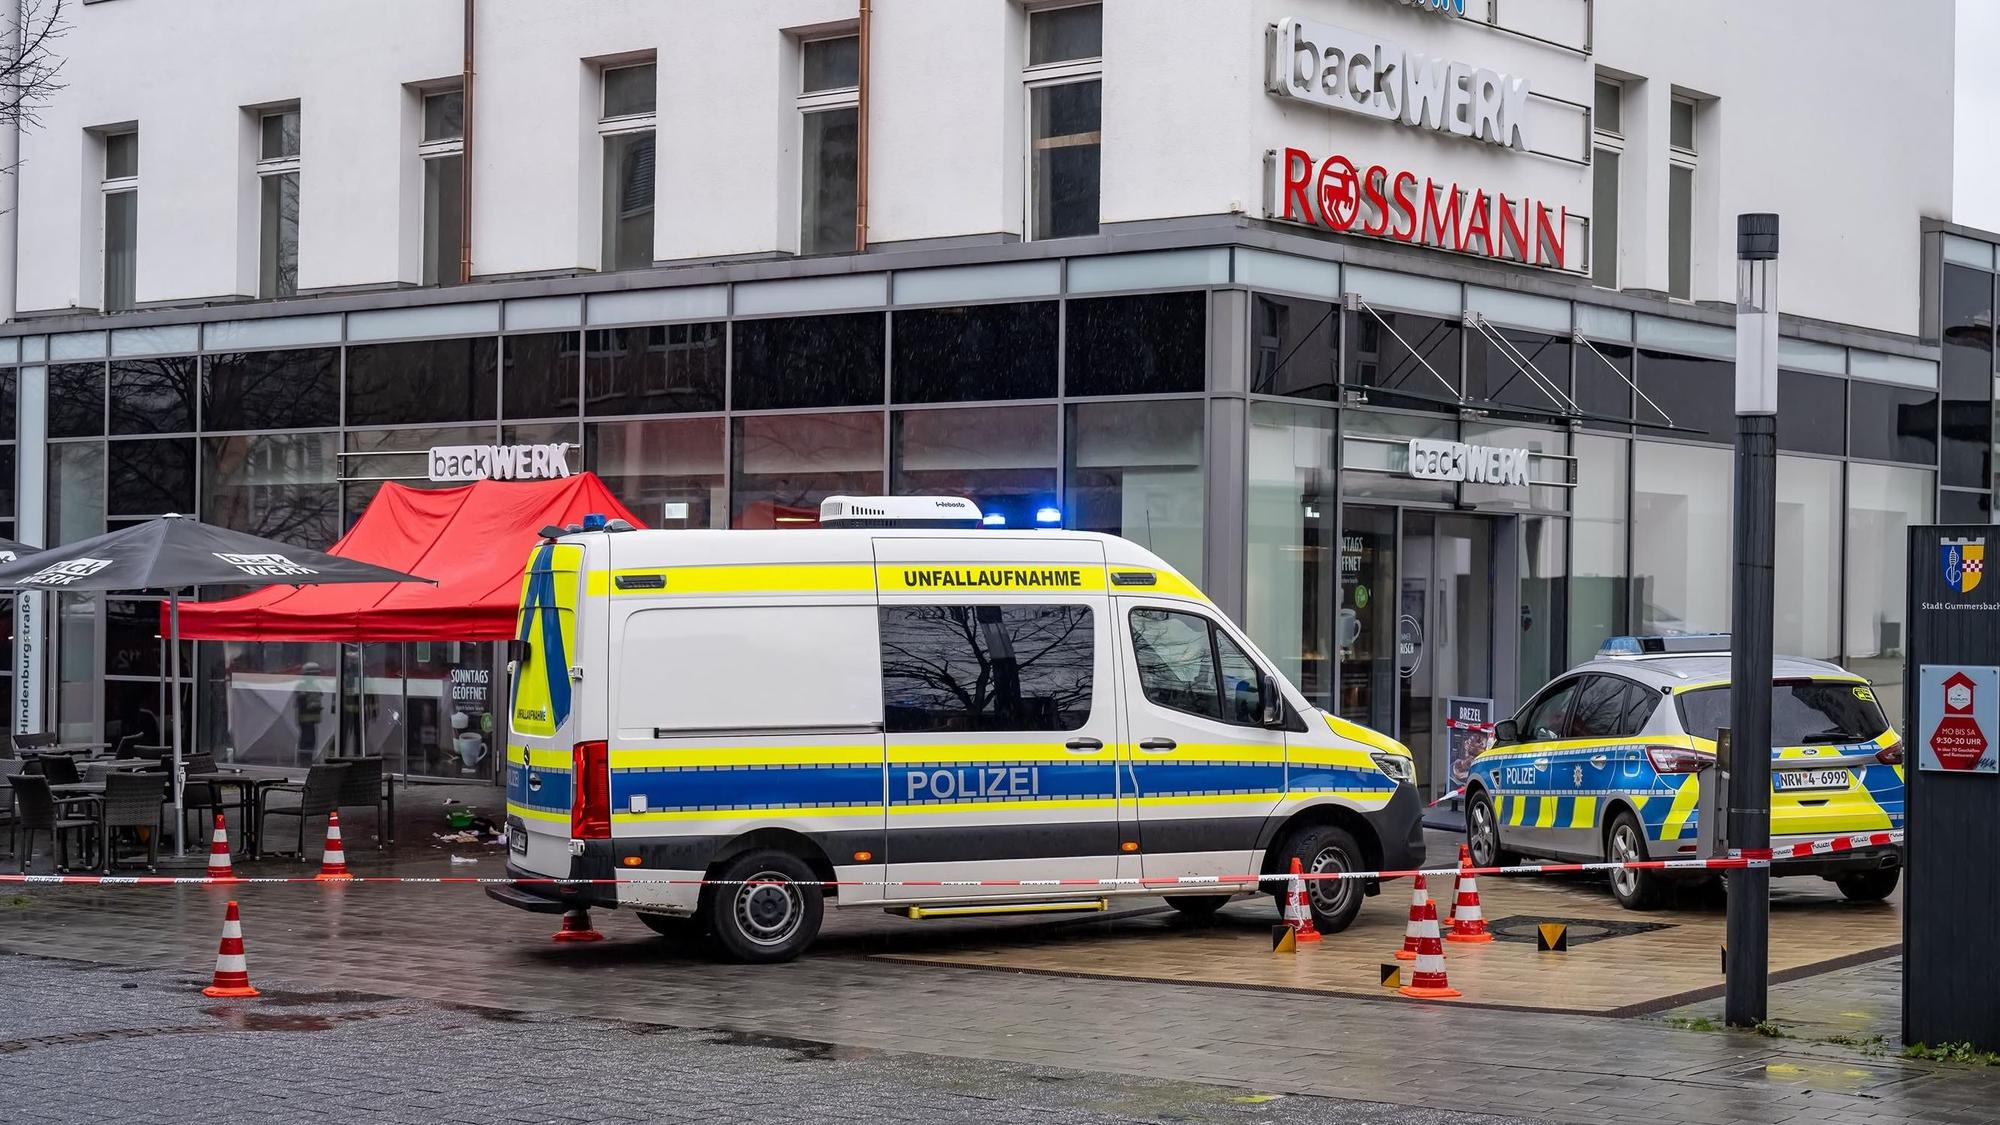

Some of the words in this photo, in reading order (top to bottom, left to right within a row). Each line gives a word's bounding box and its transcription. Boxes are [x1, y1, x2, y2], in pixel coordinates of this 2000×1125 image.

[1280, 17, 1532, 150] backWERK
[1283, 146, 1566, 269] ROSSMANN
[429, 443, 571, 481] backWERK
[1410, 439, 1529, 487] backWERK
[904, 570, 1082, 586] UNFALLAUFNAHME
[1922, 602, 1943, 610] Stadt
[1944, 602, 2000, 610] Gummersbach
[20, 594, 32, 735] Hindenburgstraße
[451, 669, 489, 683] SONNTAGS
[453, 683, 487, 700] GEÖFFNET
[1459, 707, 1481, 721] BREZEL
[1955, 728, 1965, 736] BIS
[907, 767, 1039, 799] POLIZEI
[1506, 767, 1536, 785] POLIZEI
[1780, 773, 1802, 787] NRW
